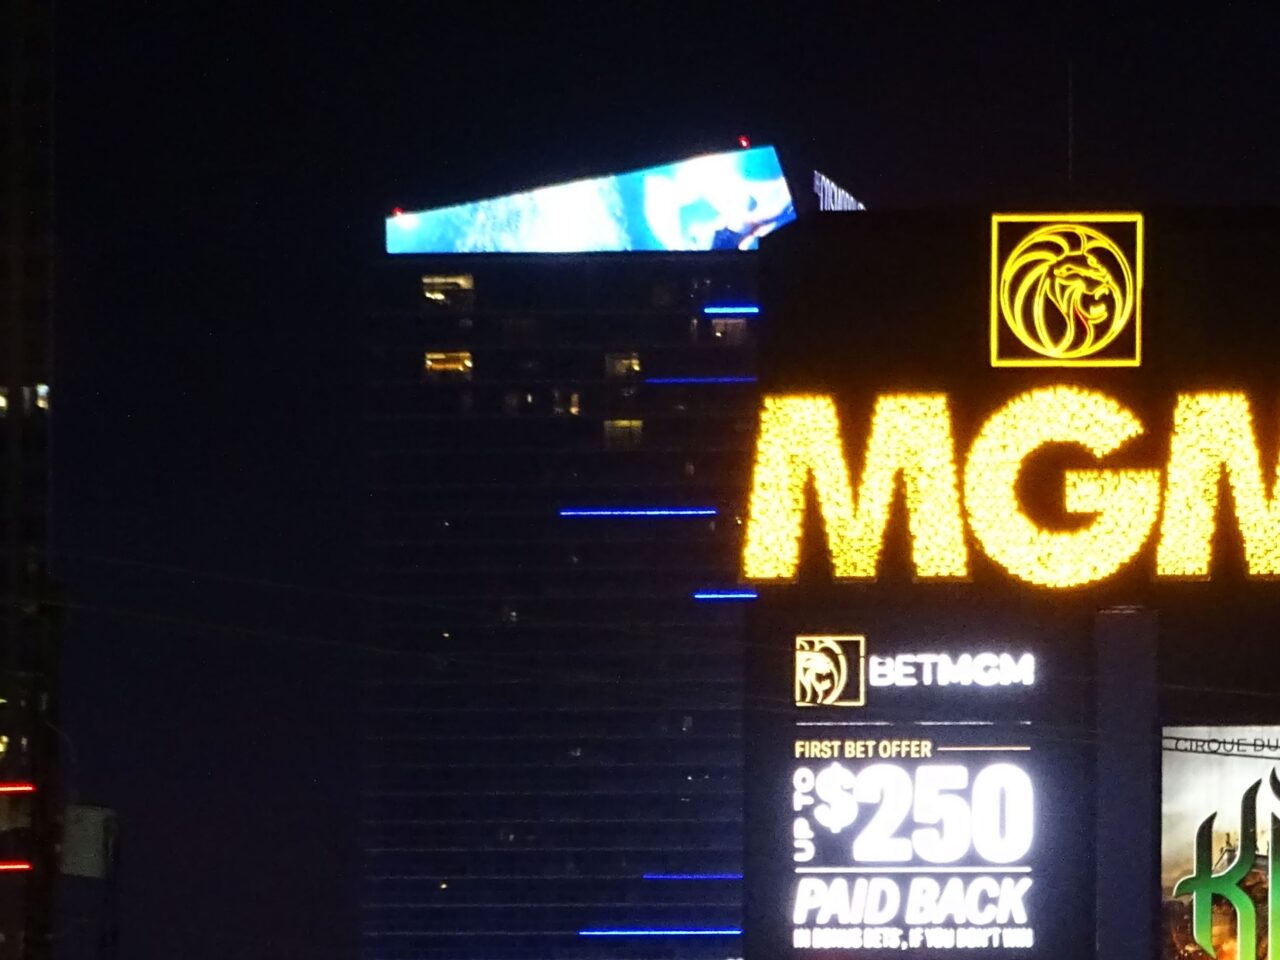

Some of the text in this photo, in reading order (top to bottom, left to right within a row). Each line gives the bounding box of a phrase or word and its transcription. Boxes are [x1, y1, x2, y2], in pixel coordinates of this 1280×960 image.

[868, 653, 1035, 686] BETMGM
[794, 740, 932, 758] FIRST BET OFFER
[1174, 736, 1247, 752] CIRQUE
[1253, 738, 1279, 752] DU
[793, 767, 815, 862] UP TO
[813, 761, 1034, 864] $250
[793, 876, 1033, 925] PAID BACK
